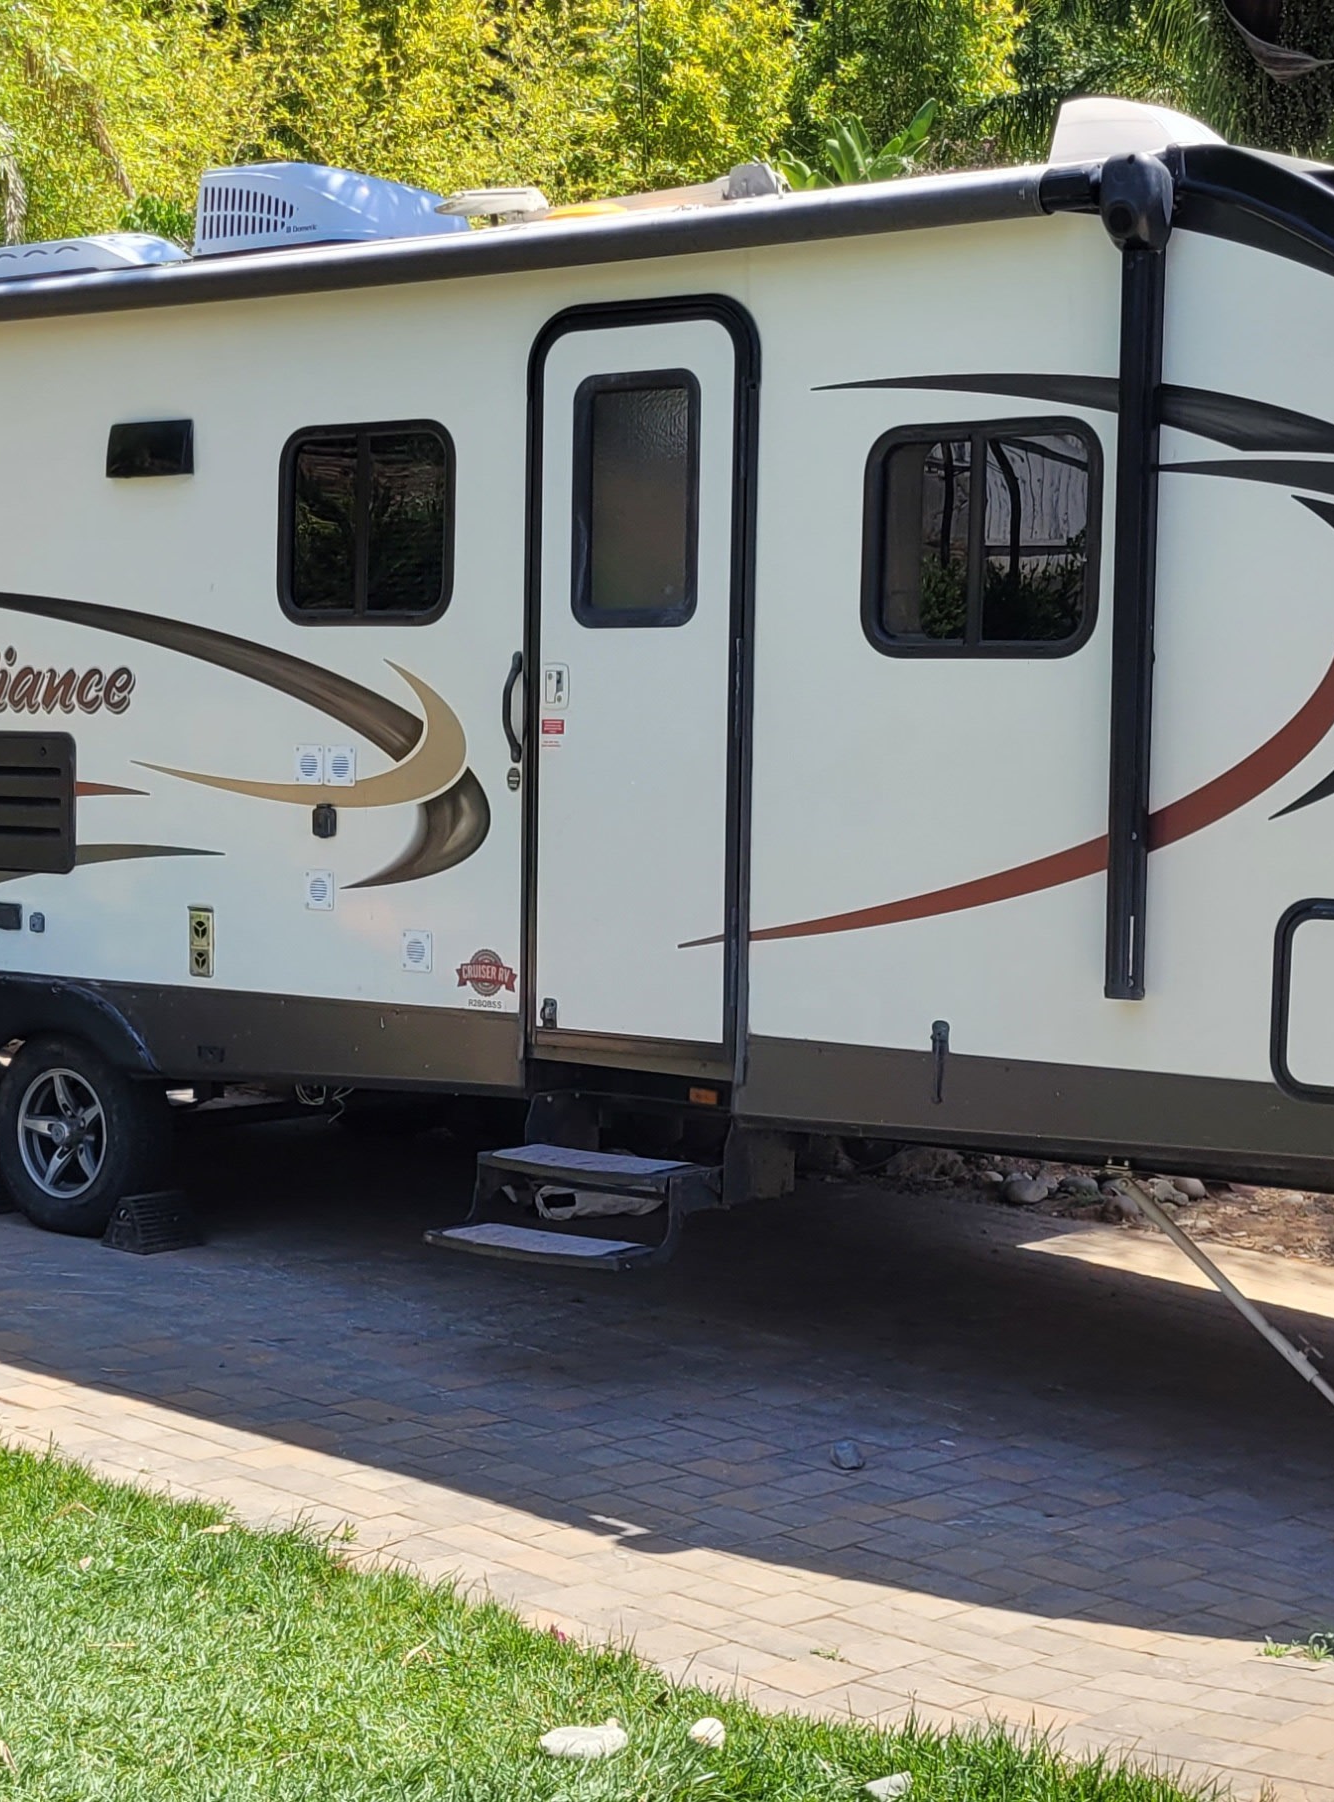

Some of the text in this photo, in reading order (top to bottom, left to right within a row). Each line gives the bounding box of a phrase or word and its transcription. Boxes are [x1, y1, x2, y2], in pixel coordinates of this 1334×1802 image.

[293, 224, 317, 233] Dometic
[462, 964, 511, 983] CRUISER RV
